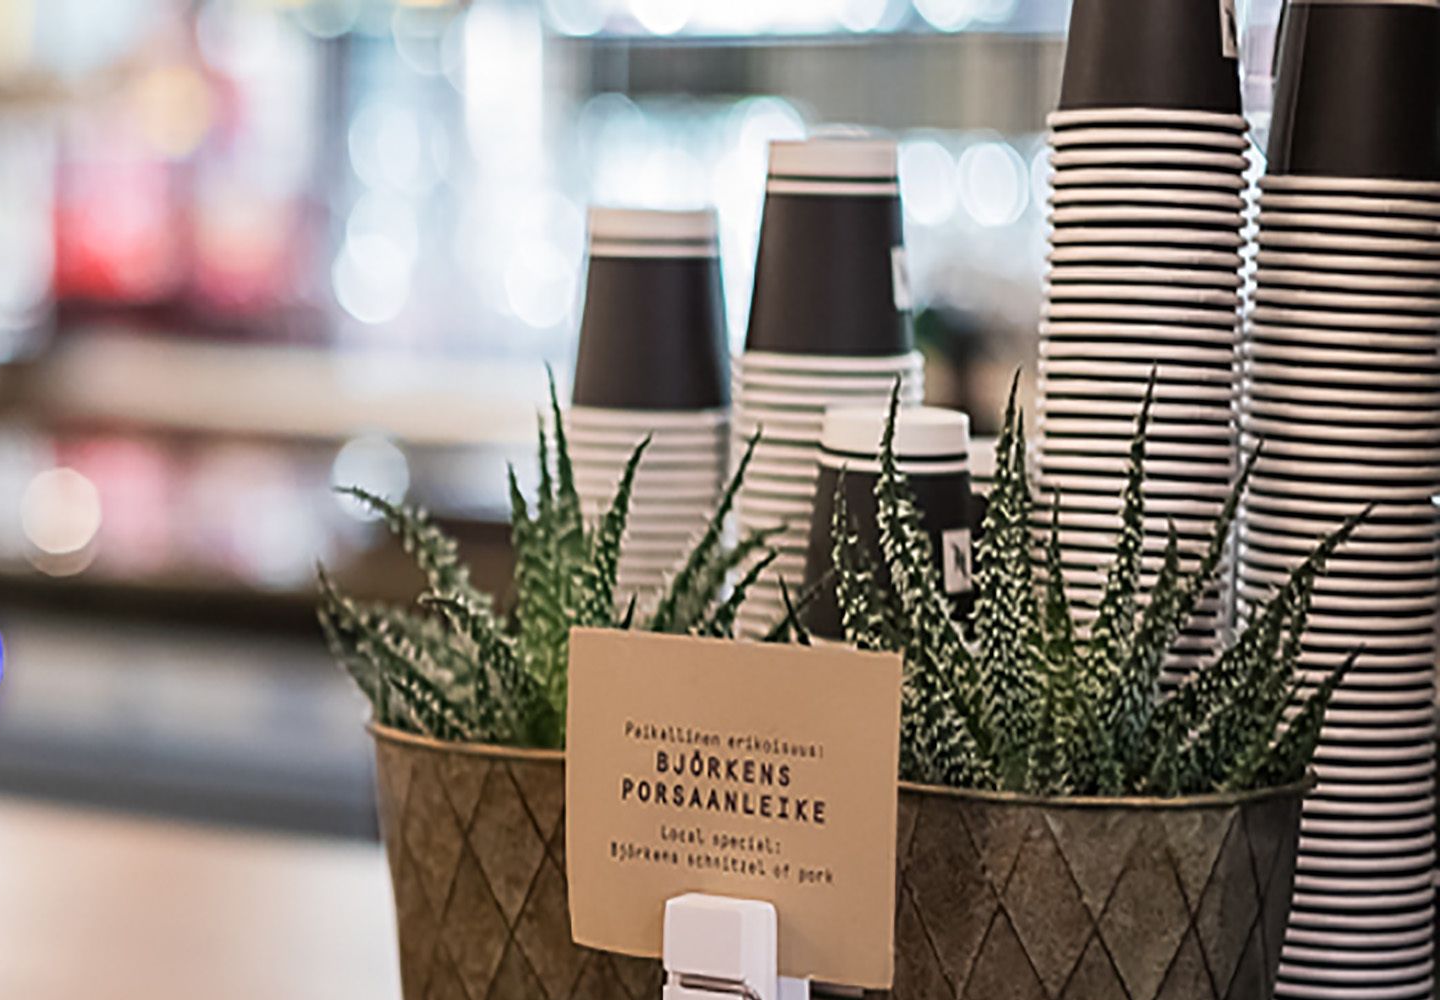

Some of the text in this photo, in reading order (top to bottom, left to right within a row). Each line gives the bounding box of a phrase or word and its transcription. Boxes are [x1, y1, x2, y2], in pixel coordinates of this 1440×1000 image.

[624, 720, 721, 746] Paikallinen
[621, 777, 826, 824] PORSAANLEIKE
[660, 825, 781, 855] Local special:
[687, 853, 766, 876] schnitzel
[773, 863, 790, 879] of
[798, 867, 833, 884] pork
